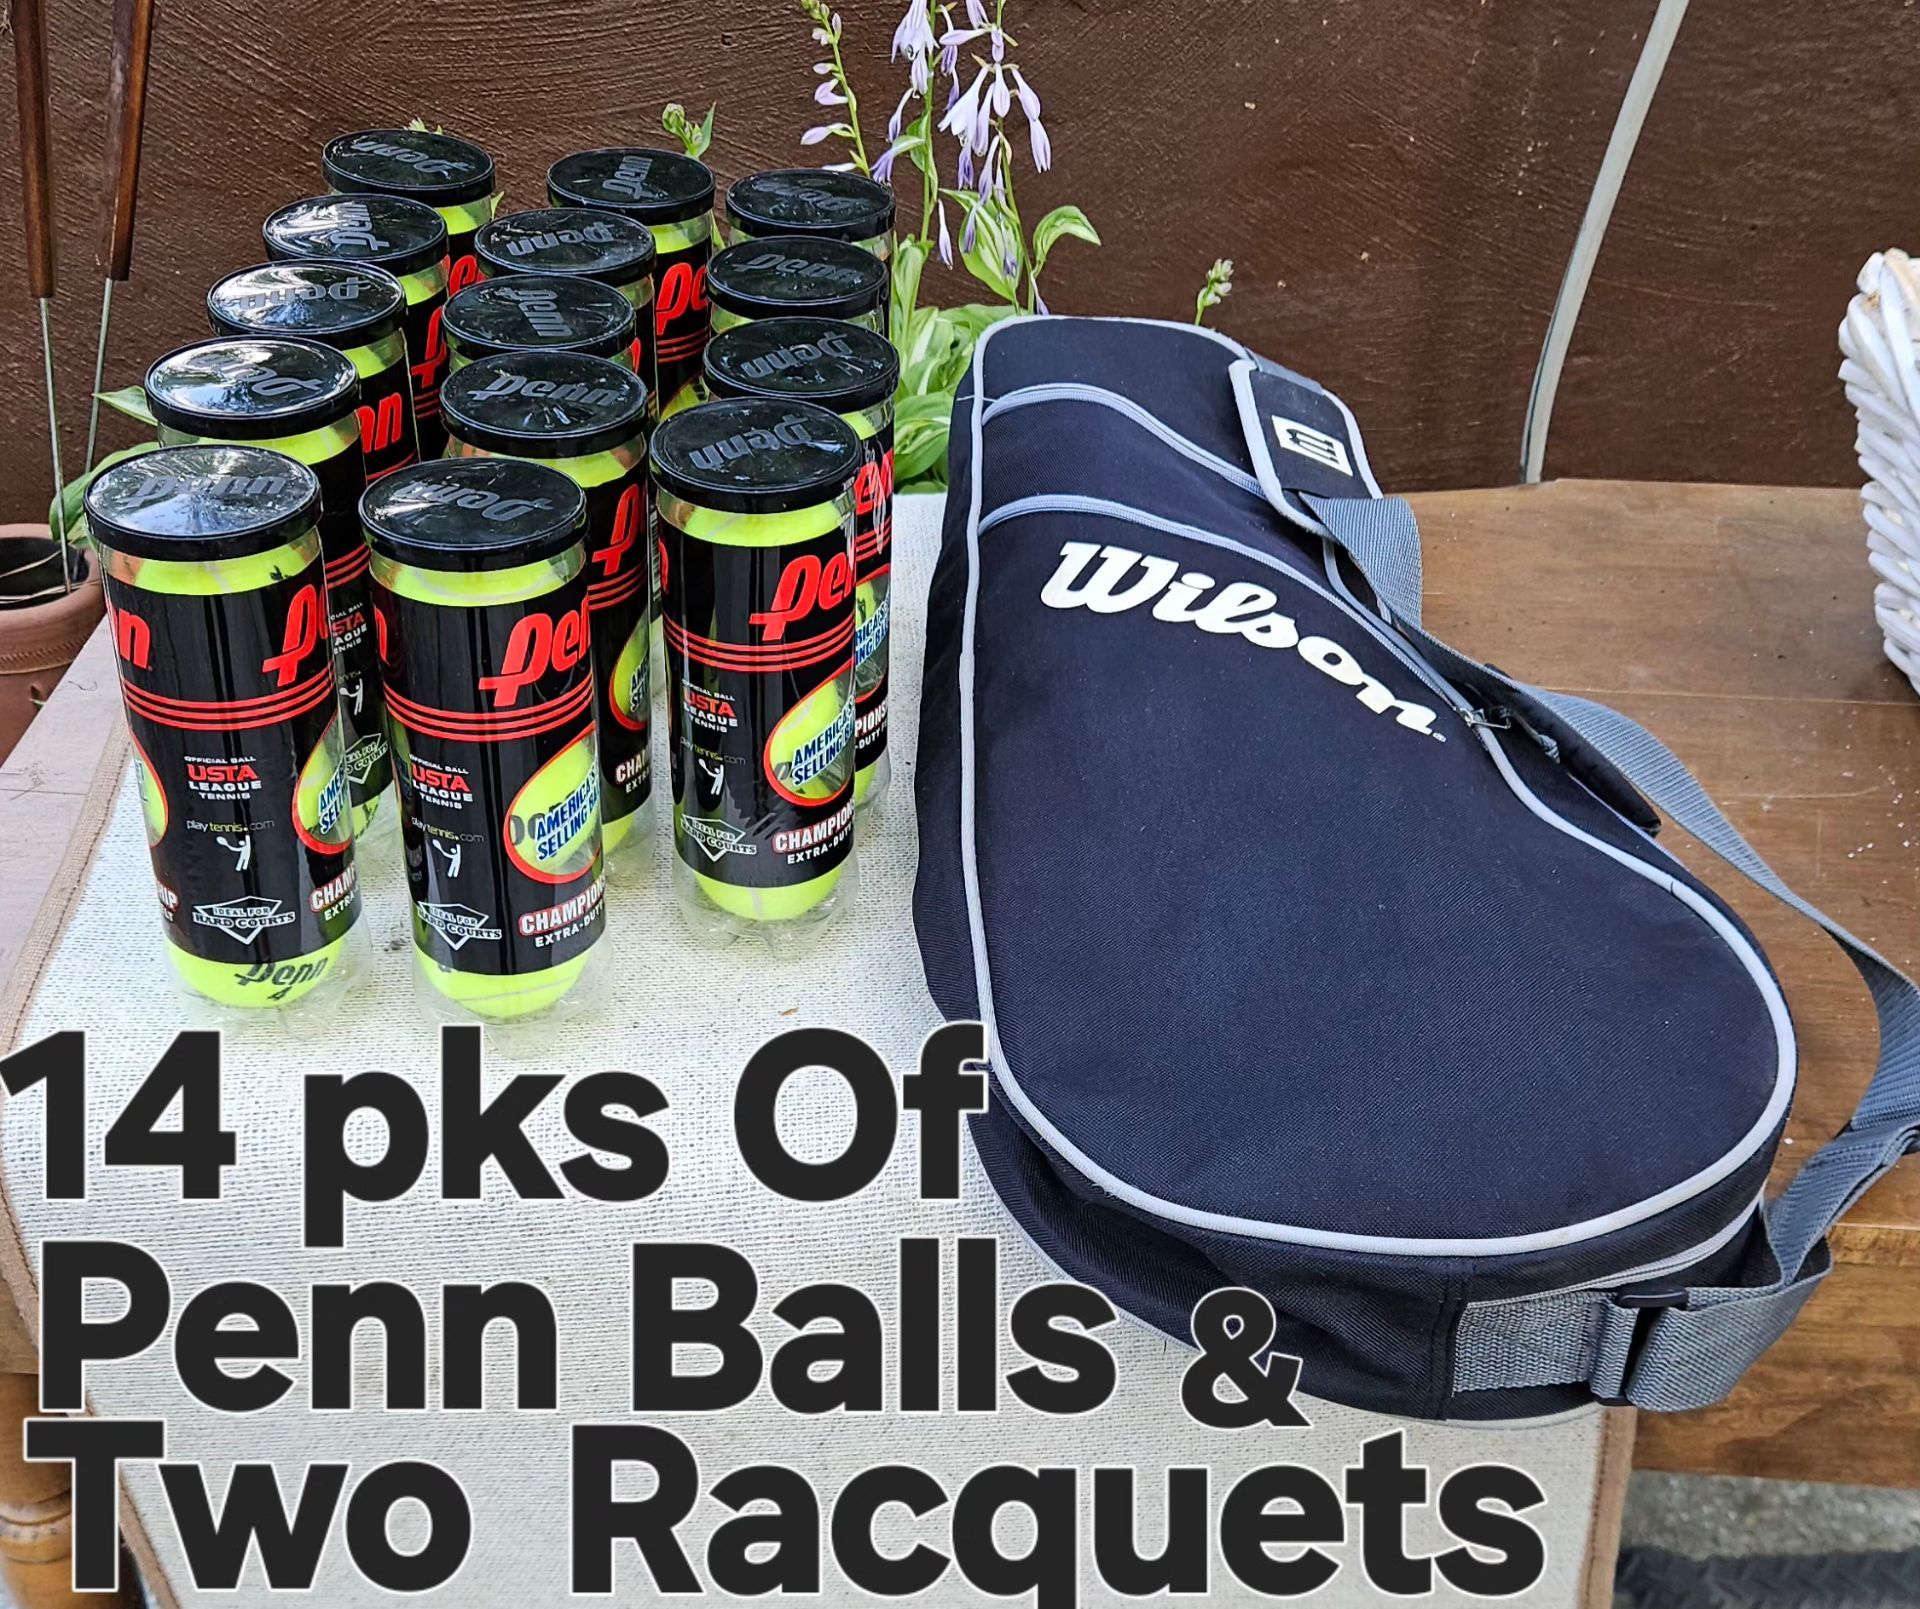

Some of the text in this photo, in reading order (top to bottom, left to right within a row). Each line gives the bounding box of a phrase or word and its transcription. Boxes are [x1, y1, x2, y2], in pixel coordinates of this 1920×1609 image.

[506, 222, 615, 256] Penn
[740, 331, 855, 378] Penn
[688, 414, 812, 470] Penn
[1040, 541, 1440, 736] Wilson
[683, 686, 736, 718] USTA
[683, 701, 738, 727] LEAGUE
[229, 755, 257, 764] BALL
[186, 763, 258, 782] USTA
[411, 763, 471, 792] USTA
[444, 765, 469, 775] BALL
[188, 779, 262, 793] LEAGUE
[412, 779, 474, 803] LEAGUE
[198, 791, 251, 801] TENNIS
[419, 792, 463, 810] TENNIS
[706, 836, 757, 856] COURTS
[212, 906, 270, 917] IDEAL FOR
[235, 911, 295, 929] COURTS
[446, 922, 502, 940] COURTS
